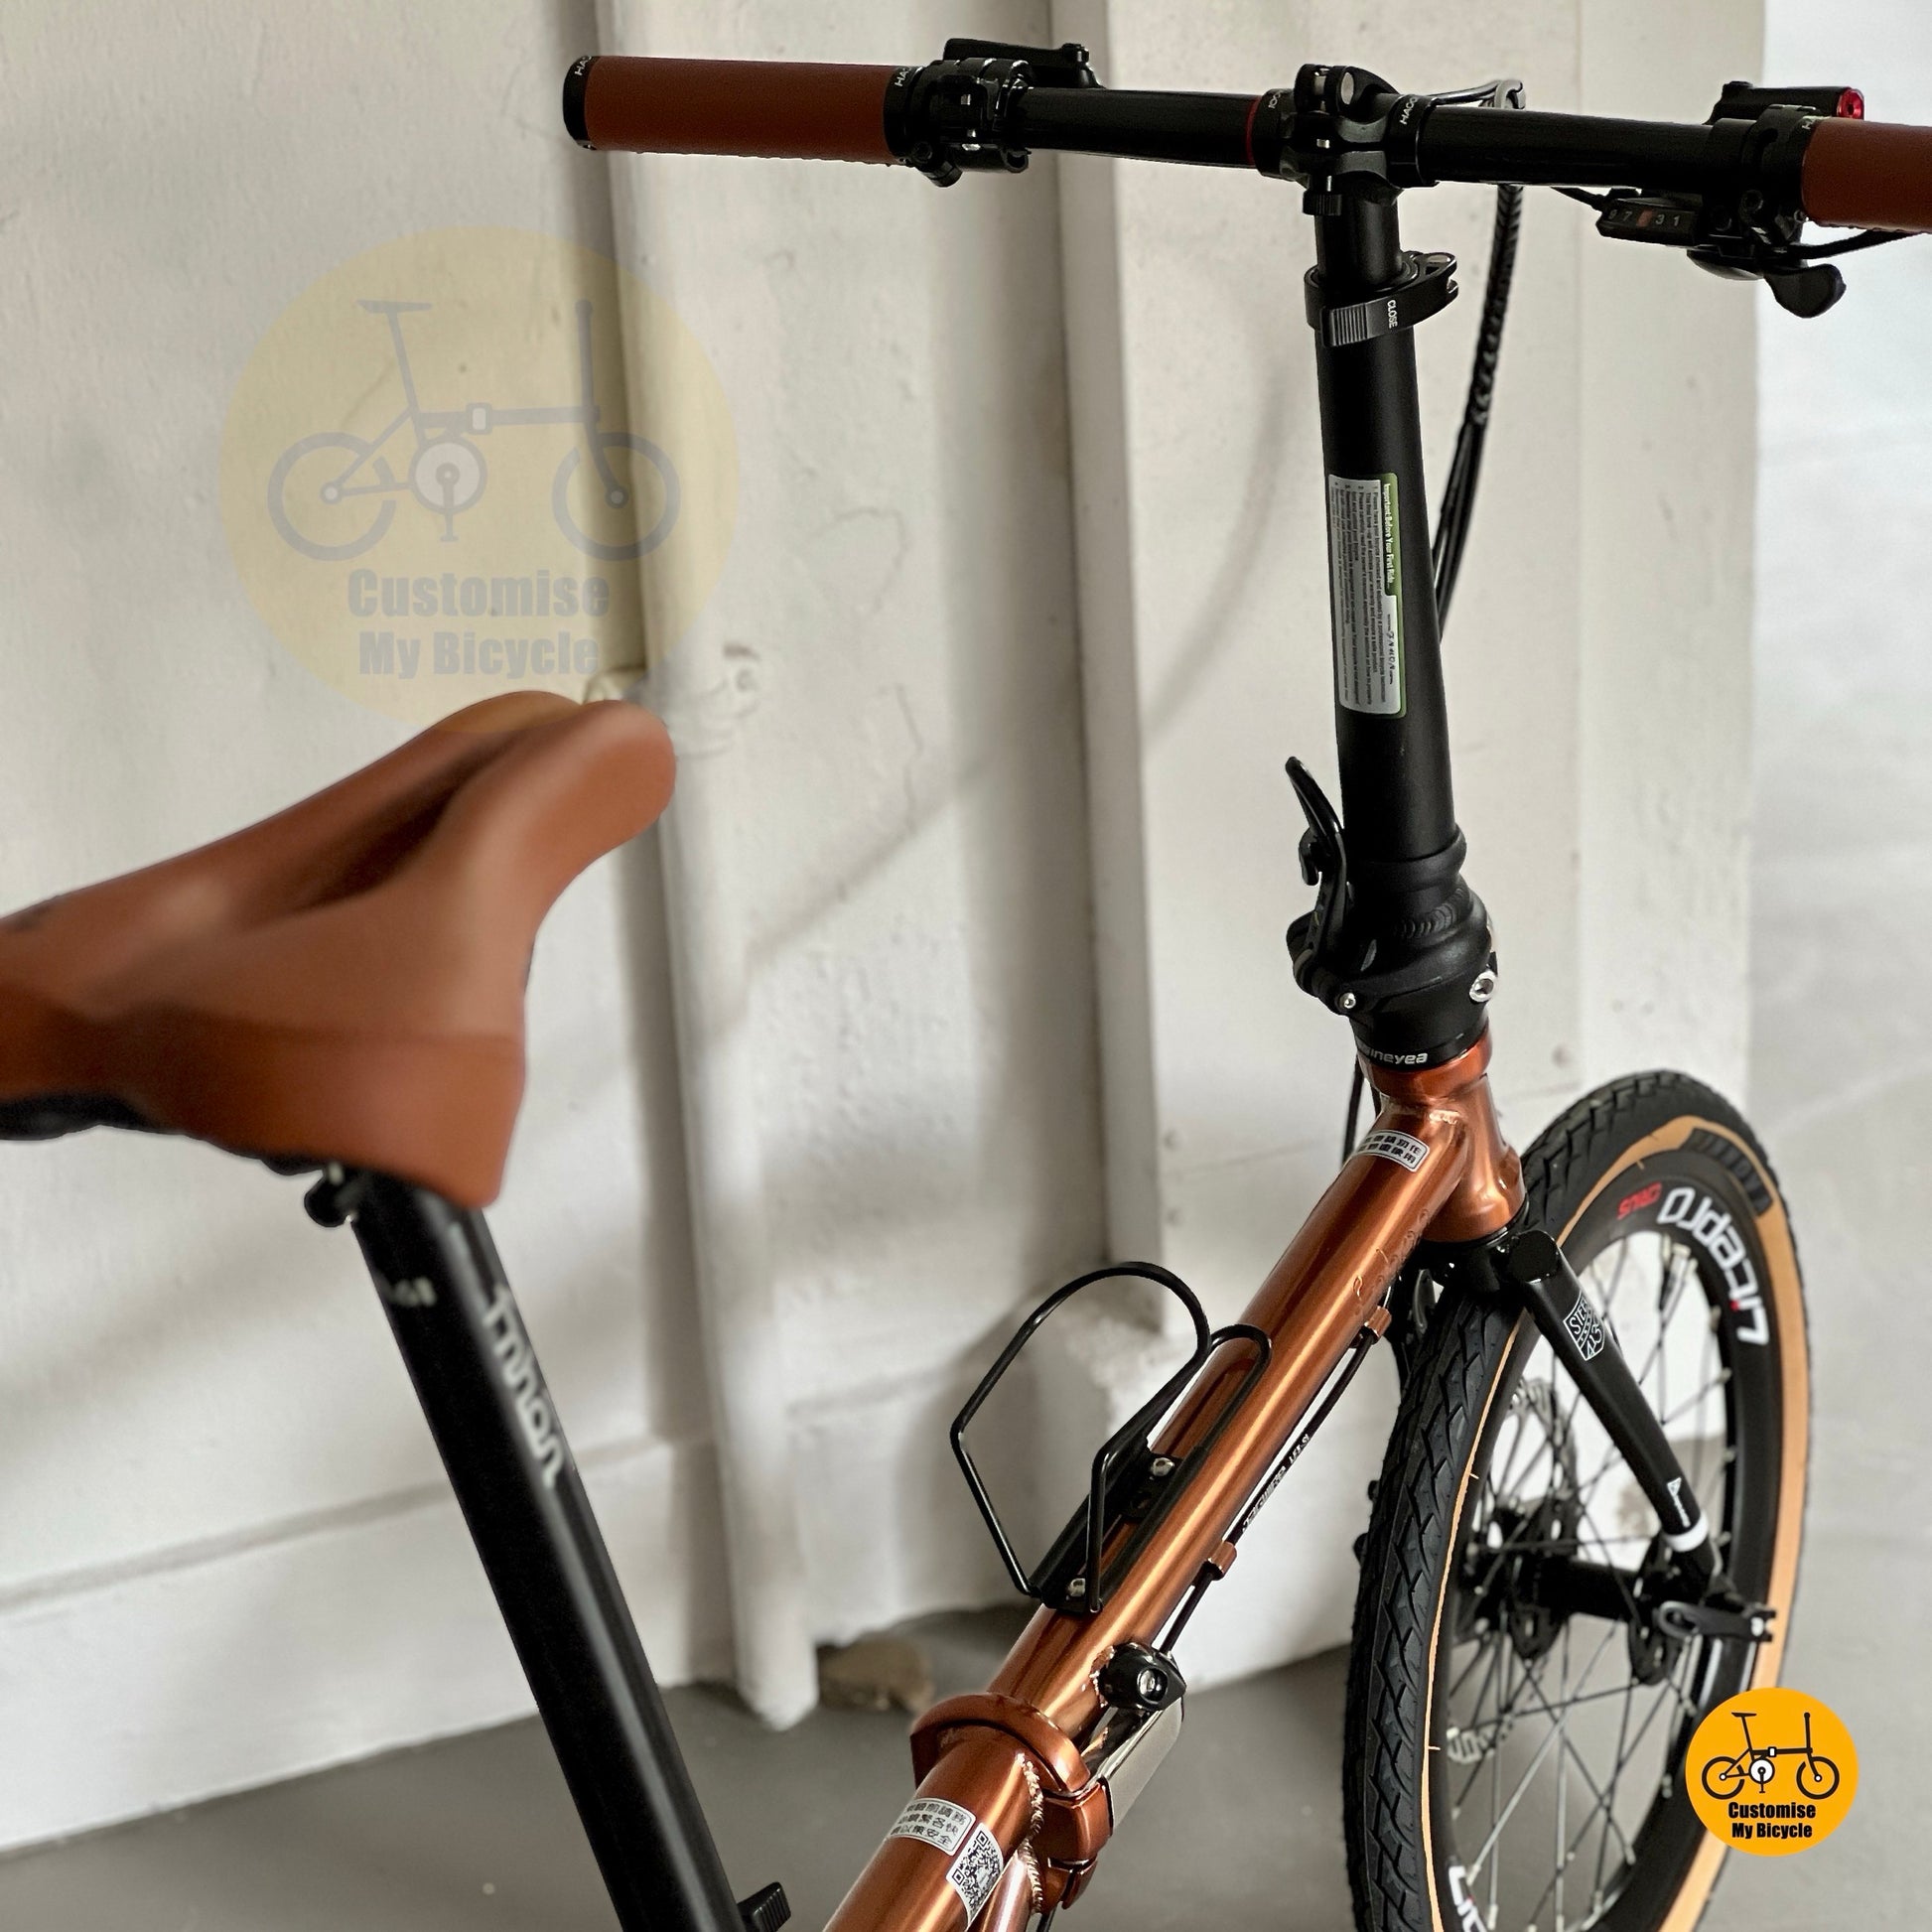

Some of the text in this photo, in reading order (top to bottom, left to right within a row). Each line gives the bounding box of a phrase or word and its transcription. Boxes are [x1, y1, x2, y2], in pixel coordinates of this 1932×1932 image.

[1655, 213, 1665, 225] 3
[1673, 215, 1681, 226] 1
[1387, 299, 1398, 329] CLOSE
[1569, 1295, 1589, 1335] STEE
